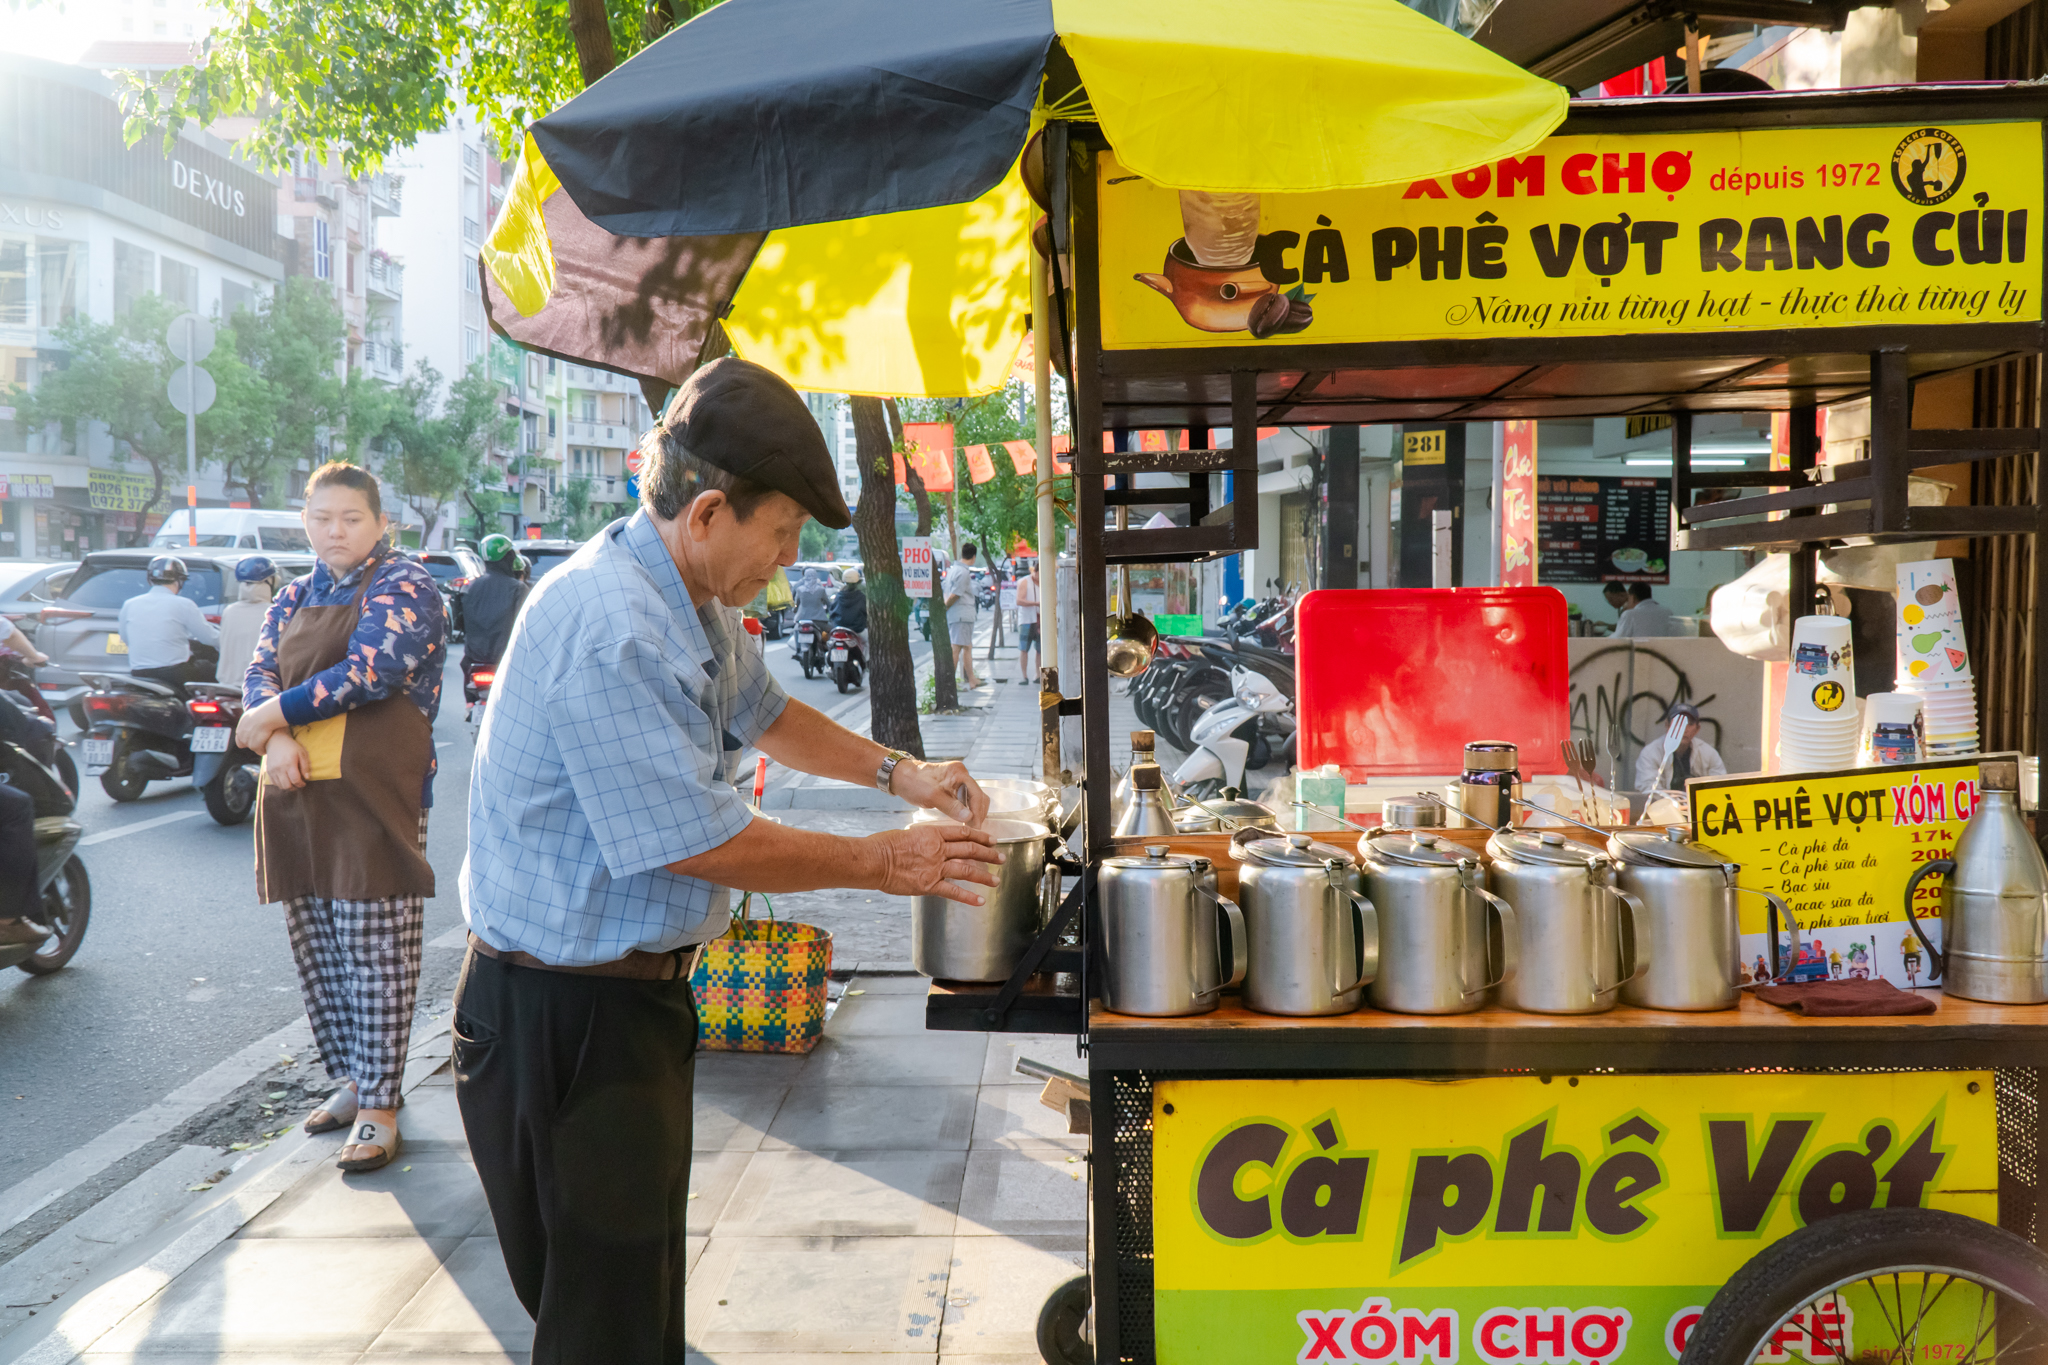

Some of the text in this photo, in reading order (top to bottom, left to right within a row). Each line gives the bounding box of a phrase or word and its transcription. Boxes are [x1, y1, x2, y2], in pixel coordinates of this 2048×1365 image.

[1934, 130, 1964, 158] COFFEE
[172, 159, 245, 217] DEXUS
[1561, 150, 1693, 202] CHỢ
[1709, 165, 1805, 195] dépuis
[1815, 162, 1881, 188] 1972
[0, 203, 64, 230] XUS
[1254, 192, 2028, 287] CÀ PHÊ VỢT RANG CỦI
[1445, 296, 1551, 330] Nâng
[1559, 297, 1611, 322] niu
[1618, 294, 1690, 326] từng
[1697, 290, 1753, 322] hạt
[1779, 287, 1848, 319] thực
[1858, 284, 1910, 313] thà
[1917, 286, 1990, 318] từng
[1998, 281, 2028, 316] ly
[1408, 435, 1441, 453] 281
[904, 541, 931, 564] PHỞ
[1702, 774, 1980, 837] CÀ PHÊ VỢT XÓM CH
[1778, 841, 1799, 856] Cà
[1802, 839, 1828, 860] phê
[1833, 837, 1850, 851] đá
[1911, 829, 1953, 843] 17k
[1779, 860, 1800, 875] Cà
[1804, 857, 1829, 879] phê
[1861, 853, 1878, 868] đá
[1781, 879, 1808, 896] Bạc
[1858, 891, 1875, 906] đá
[1914, 887, 1942, 900] 20
[1808, 914, 1834, 935] phê
[1915, 905, 1942, 919] 20
[358, 1124, 376, 1140] G
[1196, 1117, 1371, 1239] Cà
[1399, 1115, 1662, 1266] phê
[1304, 1302, 1846, 1365] XÓM CHỢ CFÉ
[1922, 1344, 1967, 1360] 1972
